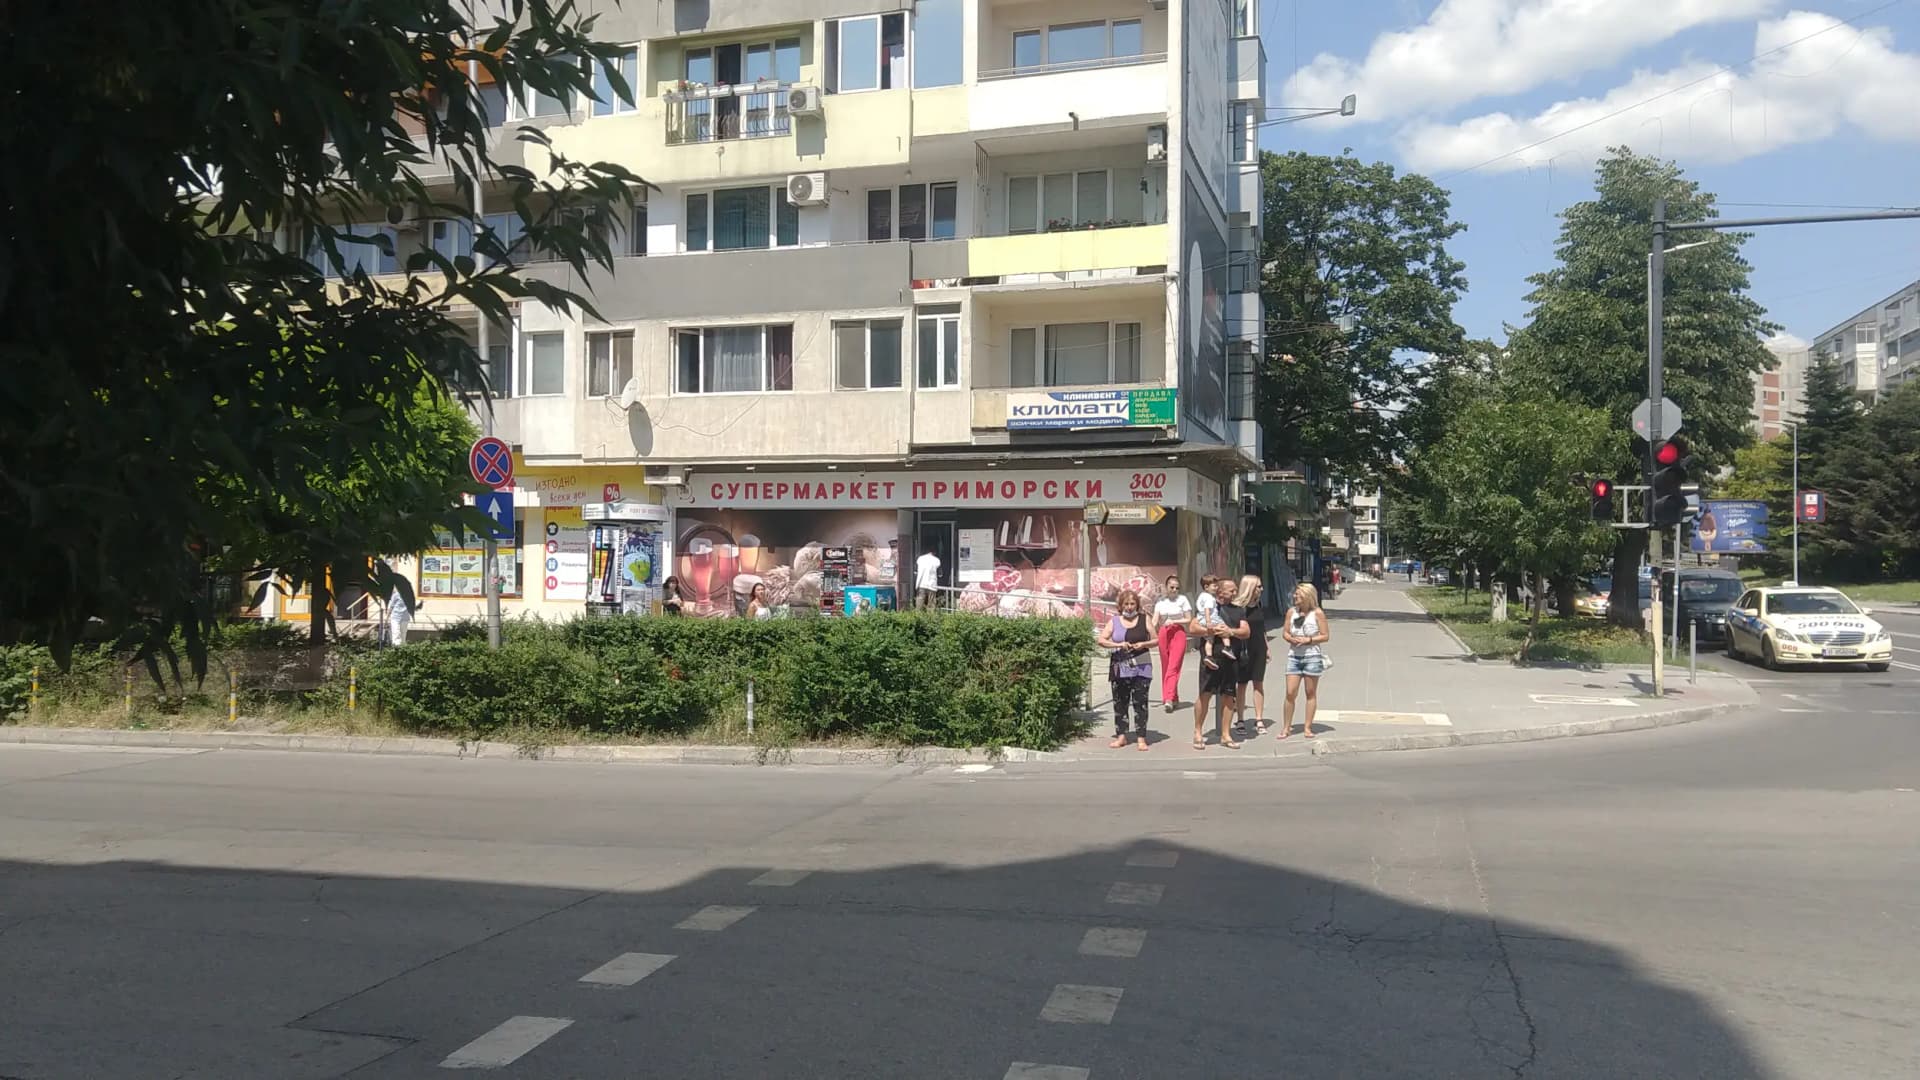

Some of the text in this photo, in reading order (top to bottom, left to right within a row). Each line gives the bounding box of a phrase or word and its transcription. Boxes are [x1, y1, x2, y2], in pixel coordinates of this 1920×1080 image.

[1130, 473, 1166, 489] 300
[711, 479, 1102, 500] СУПЕРМАРКЕТ ПРИМОРСКИ
[1131, 491, 1163, 499] ТРИСТА
